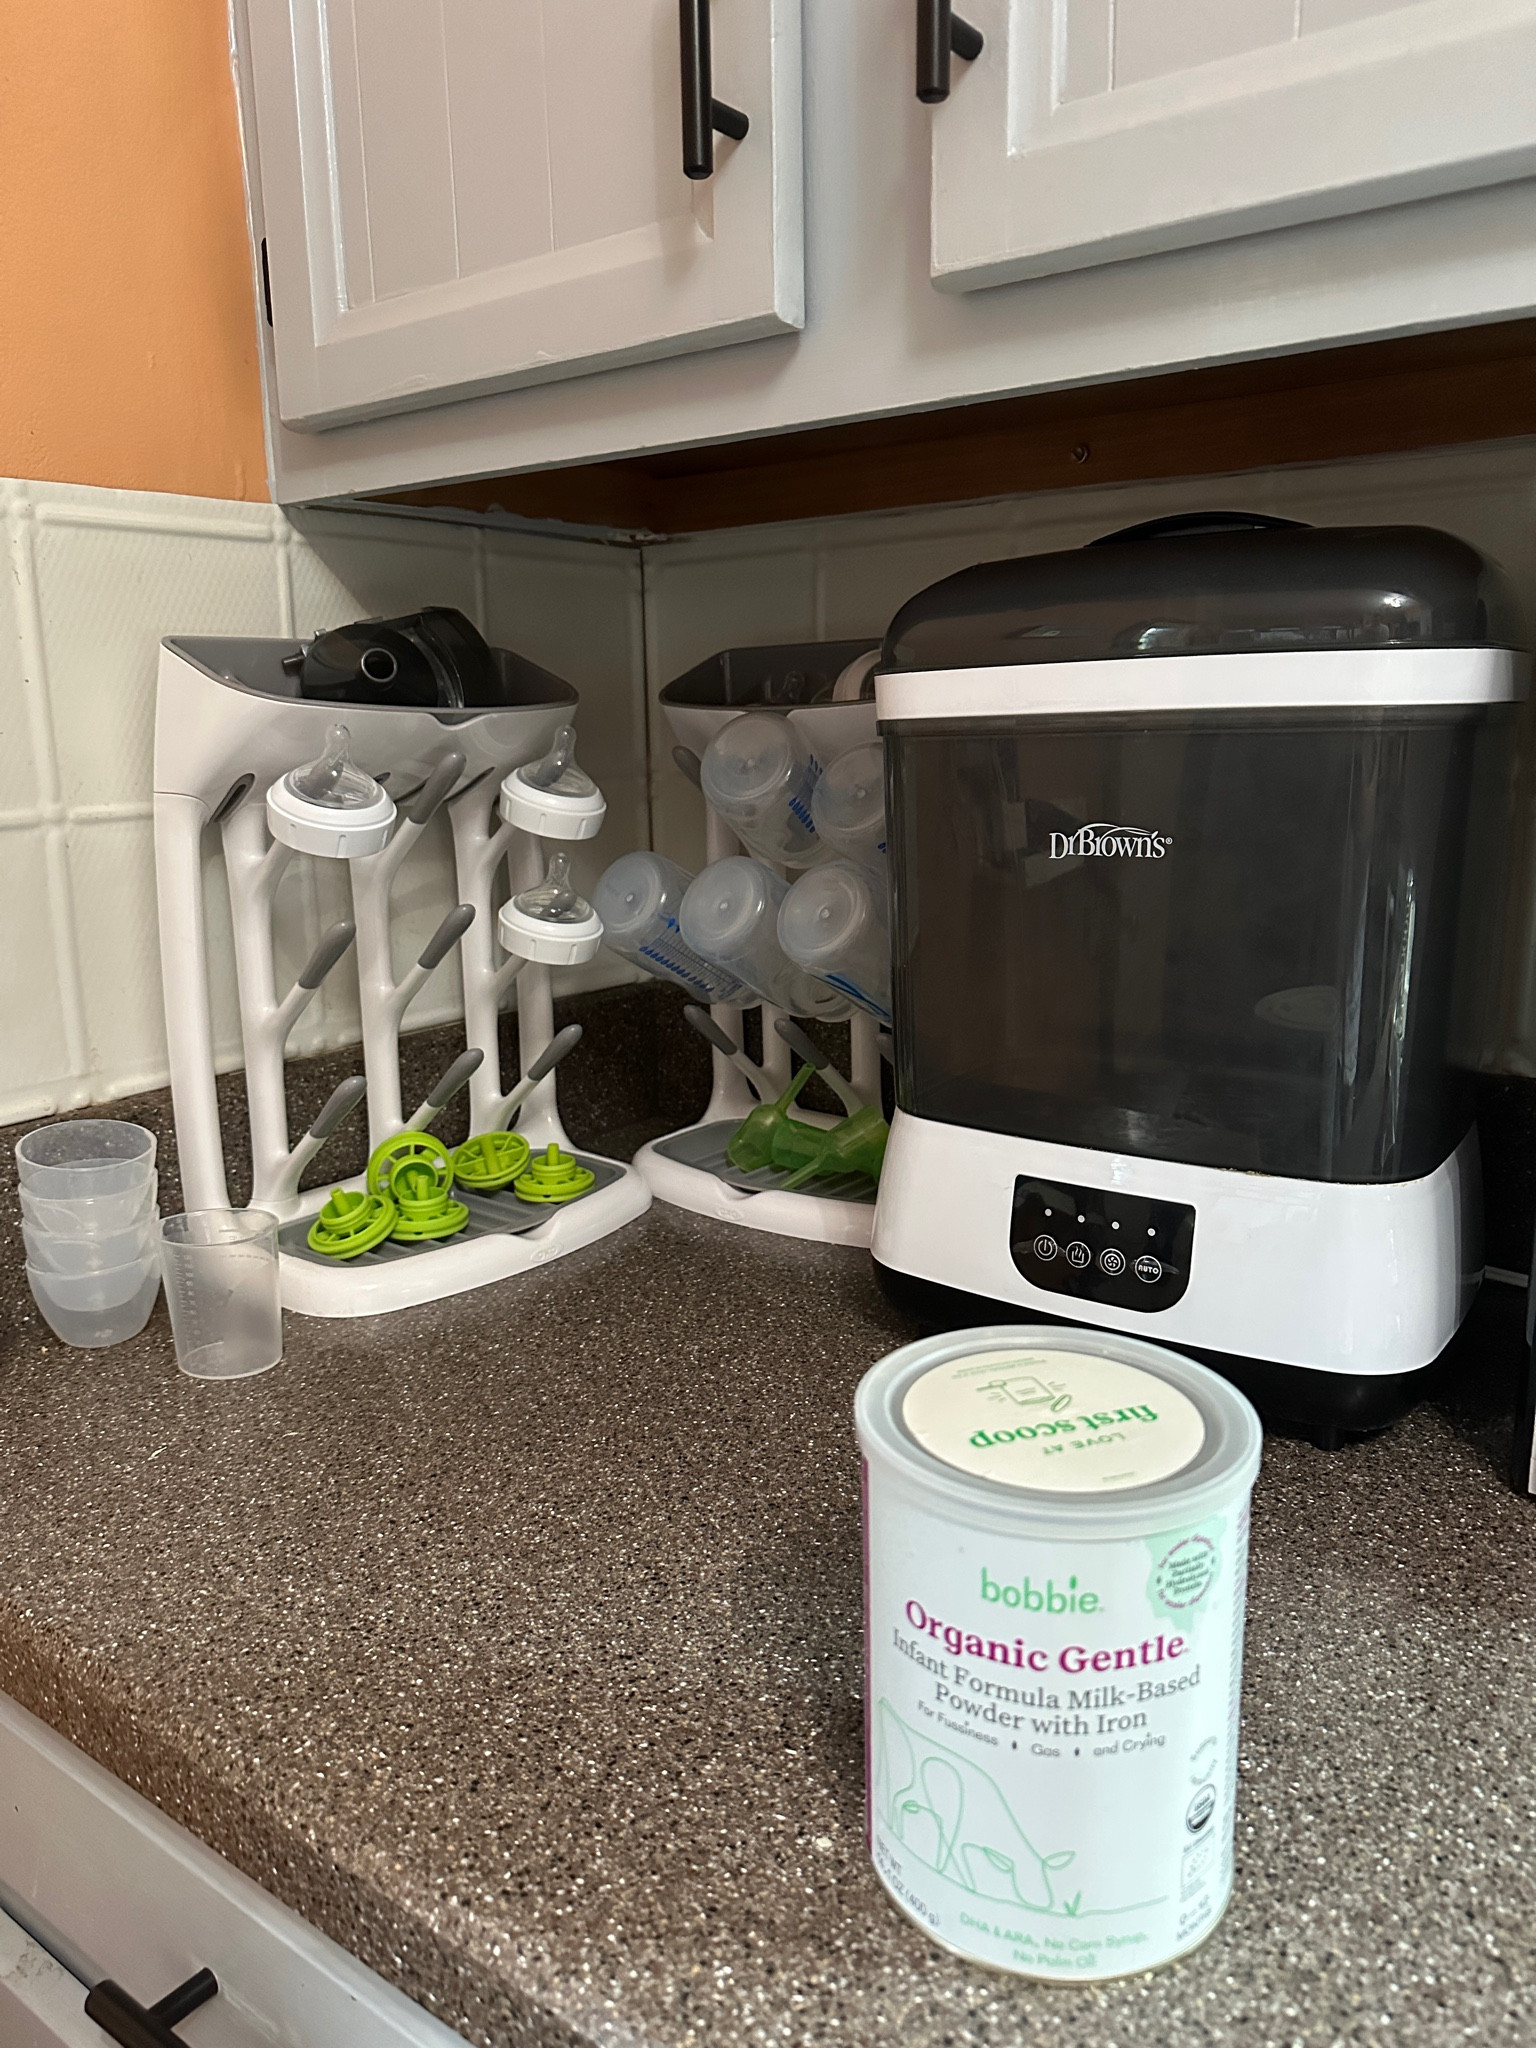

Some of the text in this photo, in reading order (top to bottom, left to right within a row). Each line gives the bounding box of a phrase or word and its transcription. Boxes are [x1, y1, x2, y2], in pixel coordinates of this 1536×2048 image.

[1137, 1264, 1160, 1275] AUTO
[968, 1403, 1159, 1449] first scoop
[1043, 1433, 1126, 1455] LOVE AT
[980, 1566, 1100, 1614] bobbie
[905, 1599, 1185, 1674] Organic Gentle
[892, 1628, 1202, 1711] Infant Formula Milk-Based
[917, 1701, 999, 1747] For Fussiness
[935, 1682, 1148, 1736] Powder with Iron
[1031, 1743, 1061, 1757] Gas
[1092, 1732, 1166, 1757] and Crying
[1075, 1952, 1097, 1968] Oil
